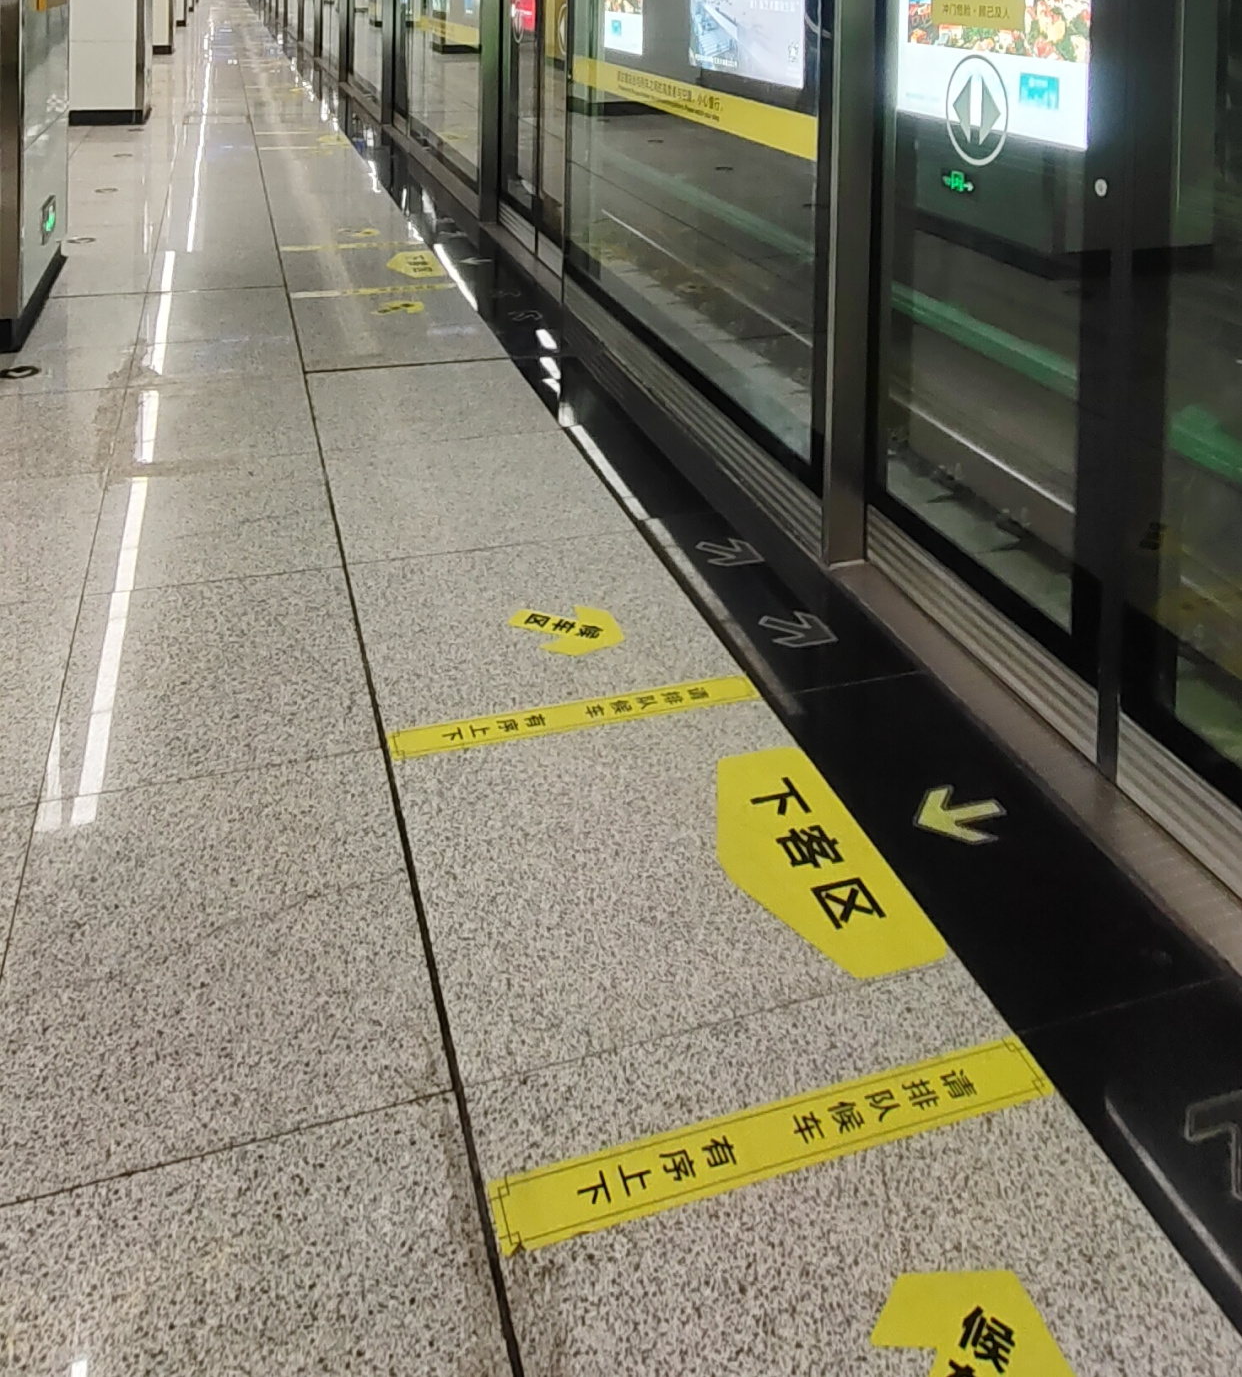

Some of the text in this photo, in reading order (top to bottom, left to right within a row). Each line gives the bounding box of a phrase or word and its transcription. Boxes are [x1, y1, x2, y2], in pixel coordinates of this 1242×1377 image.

[525, 613, 605, 641] 候车区
[440, 685, 710, 743] 请排队候车 有序上下
[750, 776, 887, 930] 下客区
[576, 1067, 978, 1206] 请排队候车 有序上下
